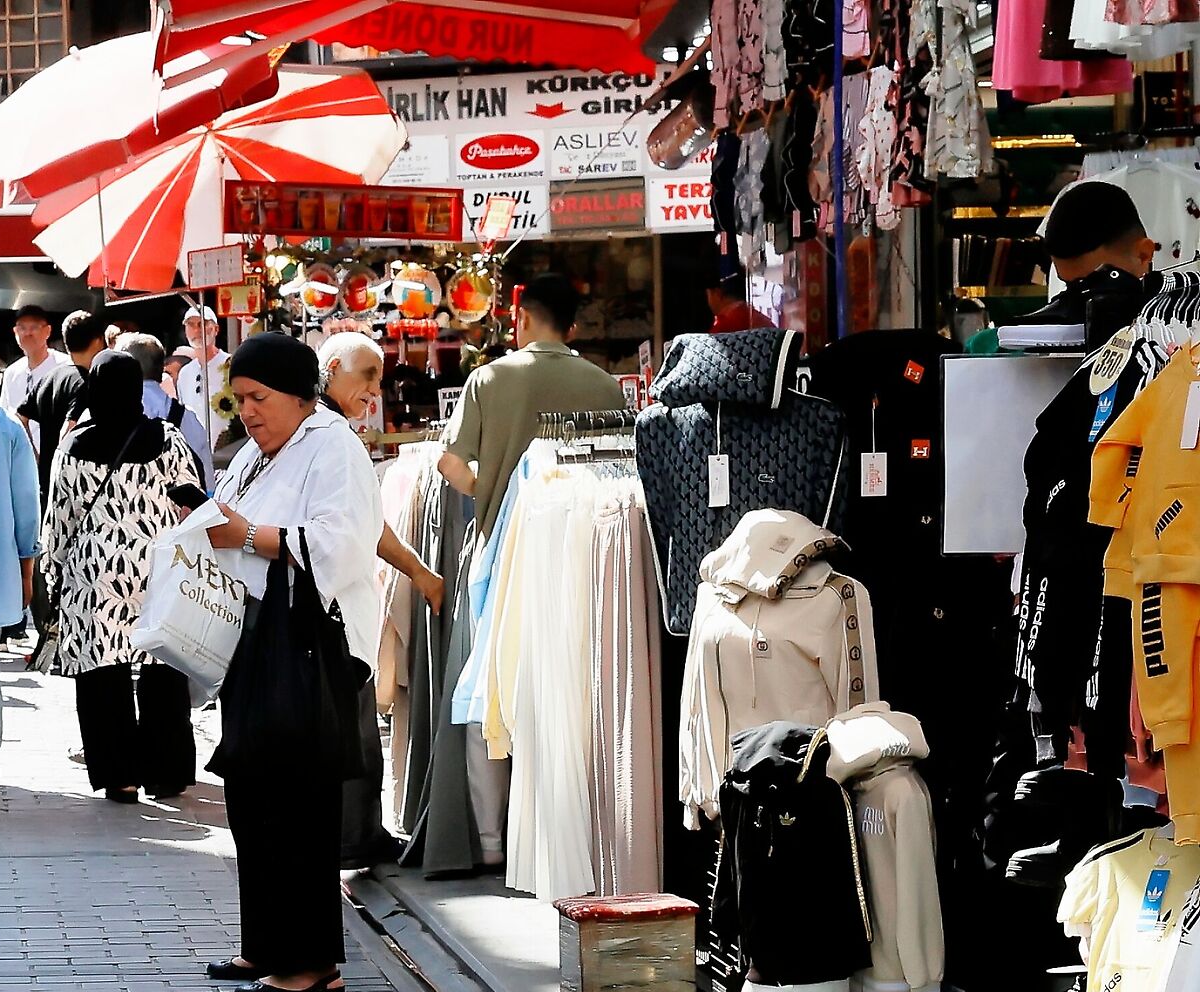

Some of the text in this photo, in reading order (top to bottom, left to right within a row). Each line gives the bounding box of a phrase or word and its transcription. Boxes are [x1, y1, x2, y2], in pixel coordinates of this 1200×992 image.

[456, 86, 507, 119] HAN
[578, 163, 618, 174] SAREV
[1153, 499, 1184, 541] PUMA
[179, 579, 243, 630] Collection
[1027, 576, 1049, 651] adidas
